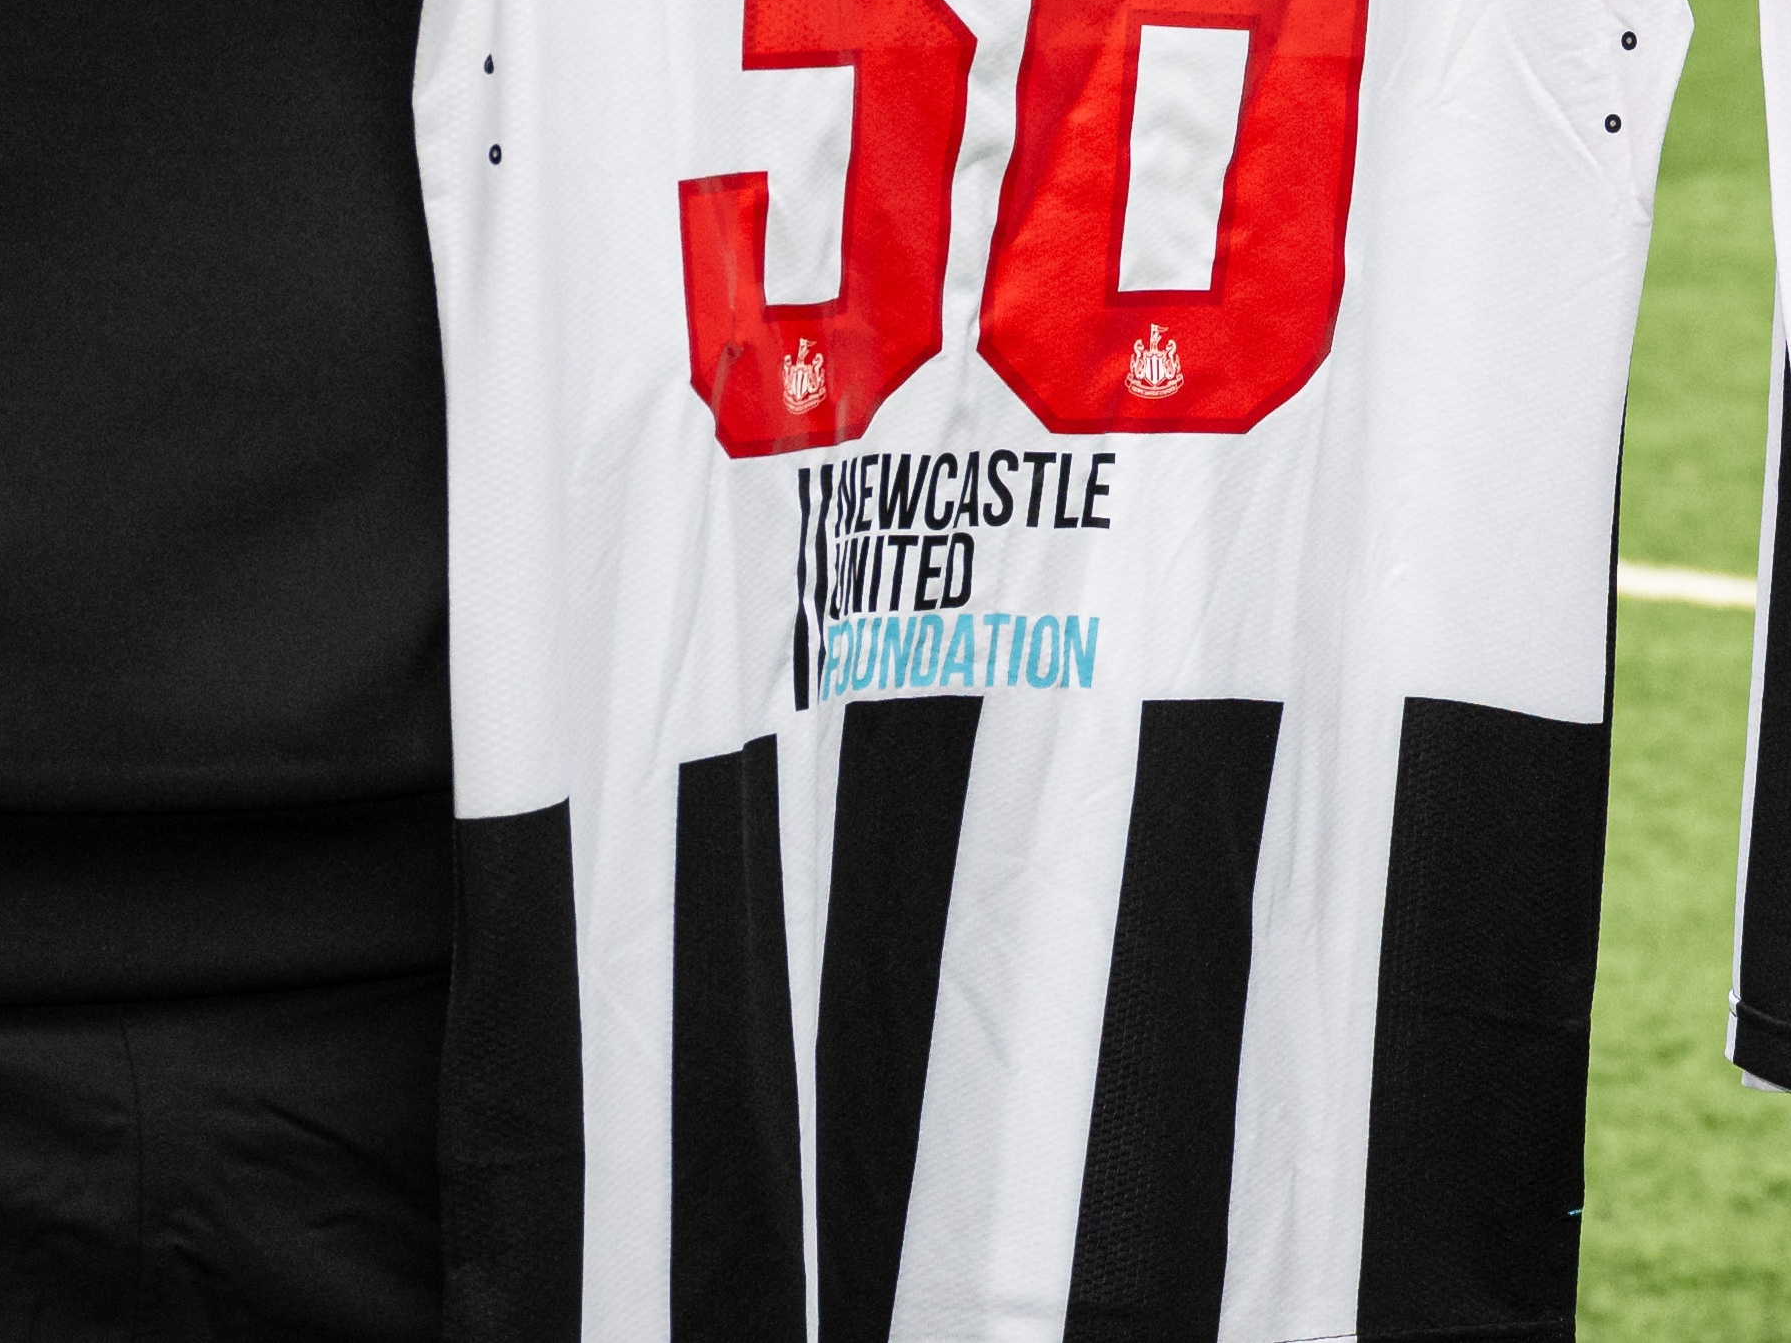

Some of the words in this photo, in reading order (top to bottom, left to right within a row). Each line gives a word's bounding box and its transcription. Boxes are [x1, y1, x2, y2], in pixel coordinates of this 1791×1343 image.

[834, 449, 1117, 538] NEWCASTLE
[828, 531, 976, 621] UNITED
[821, 612, 1100, 702] FOUNDATION
